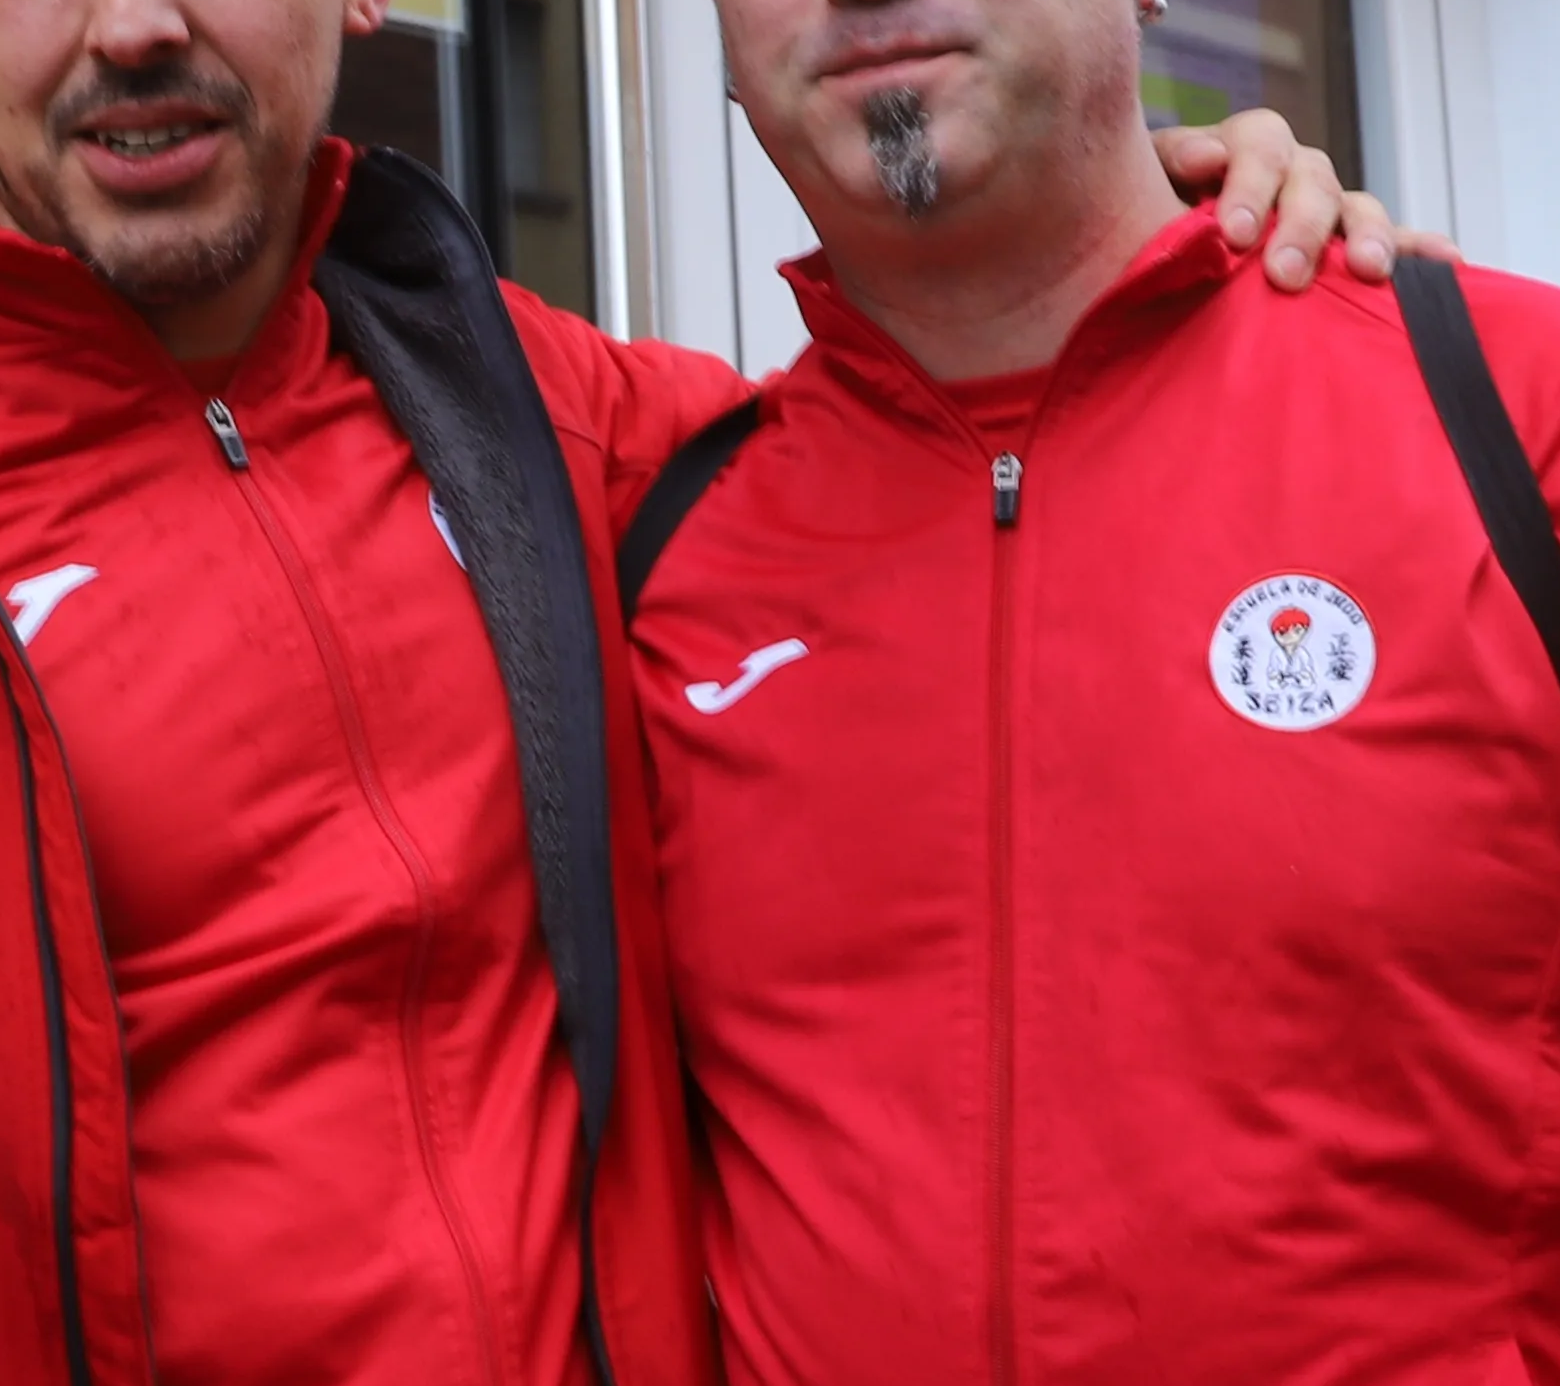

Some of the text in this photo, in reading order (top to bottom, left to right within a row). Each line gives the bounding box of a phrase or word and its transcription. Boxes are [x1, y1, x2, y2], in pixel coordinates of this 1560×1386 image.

[1221, 578, 1364, 634] ESCUELA DE JUDO
[1244, 688, 1337, 715] SEIZA
